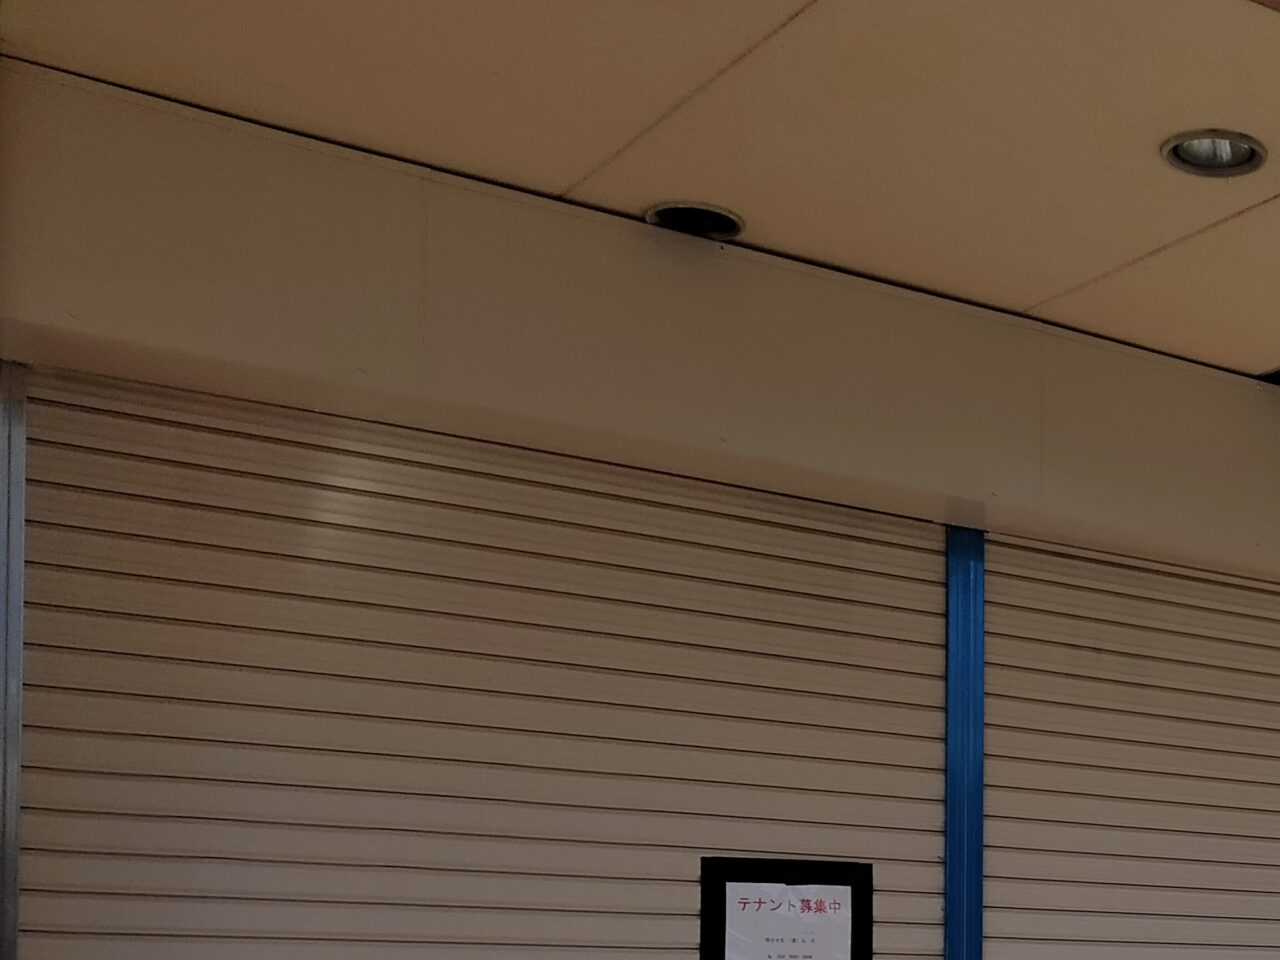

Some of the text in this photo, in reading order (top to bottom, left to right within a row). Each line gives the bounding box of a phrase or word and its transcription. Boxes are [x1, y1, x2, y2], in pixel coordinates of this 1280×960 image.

[737, 897, 841, 914] テナント募集中
